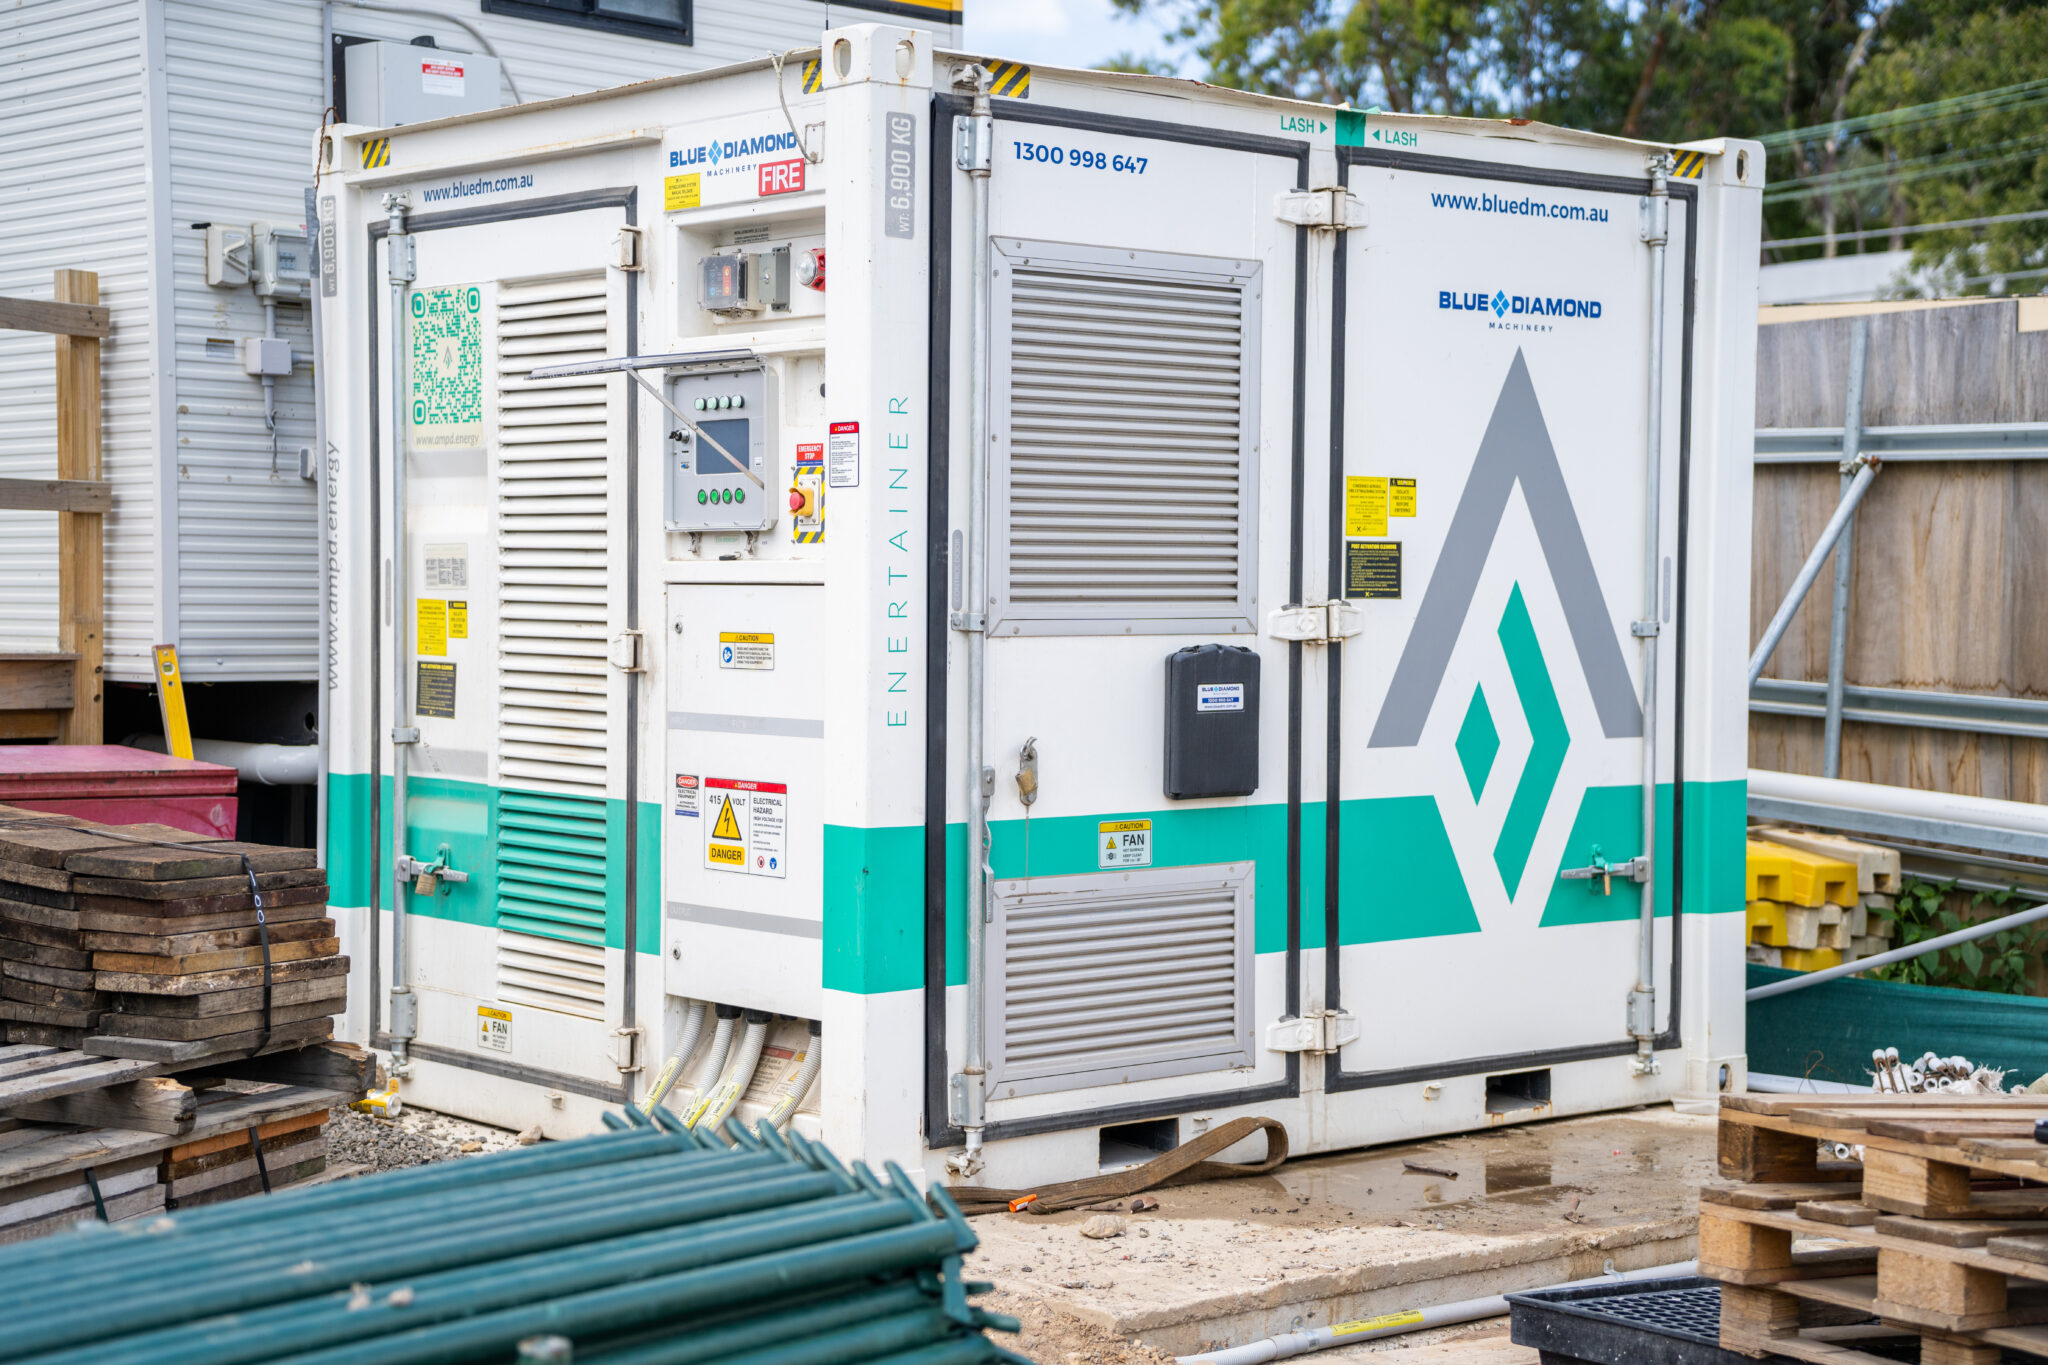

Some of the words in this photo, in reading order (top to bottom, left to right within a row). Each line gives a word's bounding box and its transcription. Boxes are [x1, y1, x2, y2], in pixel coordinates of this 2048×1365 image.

[892, 117, 911, 146] KG
[1280, 115, 1314, 134] LASH
[1384, 129, 1418, 147] LASH
[669, 146, 707, 167] BLUE
[723, 131, 797, 159] DIAMOND
[1013, 141, 1063, 167] 1300
[1069, 147, 1107, 171] 998
[1111, 152, 1148, 176] 647
[707, 163, 757, 177] MACHINERY
[761, 162, 801, 193] FIRE
[423, 174, 533, 202] www.bluedm.com.au
[890, 150, 913, 210] 6,900
[1431, 192, 1609, 223] www.bluedm.com.au
[1439, 290, 1488, 311] BLUE
[1512, 295, 1602, 319] DIAMOND
[1489, 322, 1554, 333] MACHINERY
[798, 444, 822, 453] EMERGENCY
[804, 452, 815, 460] STOP
[327, 441, 340, 690] www.ampd.energy
[887, 396, 909, 728] ENERTAINER
[678, 778, 697, 786] DANGER
[737, 782, 757, 790] DANGER
[709, 794, 721, 804] 415
[732, 798, 746, 806] VOLT
[753, 797, 783, 806] ELECTRICAL
[753, 807, 773, 815] HAZARD
[1123, 834, 1144, 846] FAN
[711, 848, 742, 861] DANGER
[492, 1021, 507, 1034] FAN
